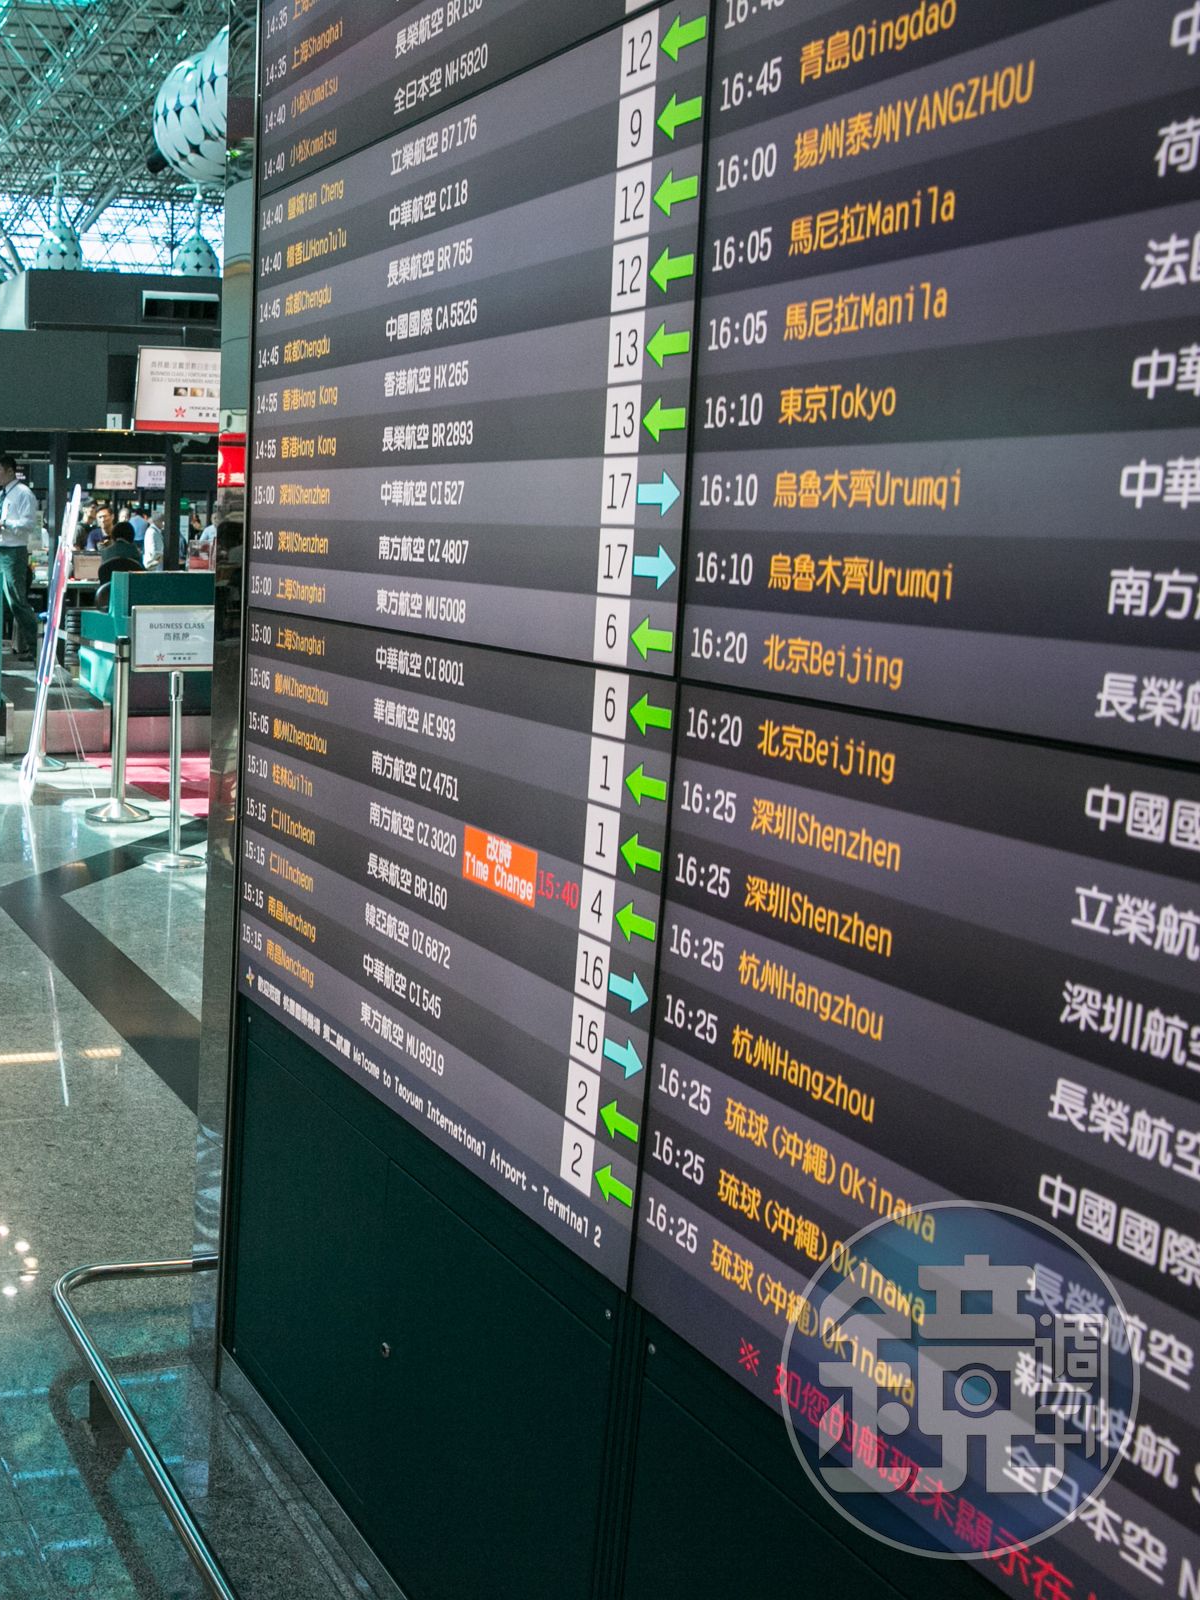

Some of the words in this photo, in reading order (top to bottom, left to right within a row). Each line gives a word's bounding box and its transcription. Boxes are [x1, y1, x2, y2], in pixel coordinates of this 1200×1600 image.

[267, 6, 288, 39] 14:35
[720, 56, 783, 112] 16:45
[800, 0, 957, 85] 青島Qingdao
[265, 55, 287, 87] 14:35
[262, 204, 283, 231] 14:40
[391, 132, 439, 176] 立榮航空
[626, 30, 653, 77] 12
[263, 152, 285, 181] 14:40
[394, 68, 442, 115] 全日本空
[264, 104, 286, 134] 14:40
[716, 142, 777, 193] 16:00
[793, 59, 1036, 172] 揚州泰州YANGZHOU
[260, 252, 282, 277] 14:40
[389, 196, 436, 231] 中華航空
[630, 108, 644, 148] 9
[712, 226, 773, 273] 16:05
[788, 185, 956, 257] 馬尼拉Manila
[259, 298, 281, 324] 14:45
[387, 249, 435, 288] 長榮航空
[619, 181, 646, 224] 12
[258, 345, 279, 369] 14:45
[386, 308, 433, 342] 中國國際
[616, 255, 643, 297] 12
[708, 309, 768, 352] 16:05
[783, 281, 949, 343] 馬尼拉Manila
[256, 392, 278, 415] 14:55
[384, 365, 431, 398] 香港航空
[613, 329, 639, 368] 13
[703, 393, 764, 429] 16:10
[778, 383, 897, 426] 東京Tokyo
[111, 416, 116, 427] 1
[255, 439, 276, 460] 14:55
[382, 424, 429, 452] 長榮航空
[610, 401, 635, 439] 13
[254, 486, 275, 505] 15:00
[381, 481, 427, 507] 中華航空
[607, 473, 632, 509] 17
[699, 473, 758, 507] 16:10
[773, 467, 962, 511] 烏魯木齊Urumqi
[253, 531, 274, 551] 15:00
[379, 536, 425, 564] 南方航空
[603, 544, 629, 580] 17
[695, 552, 754, 587] 16:10
[768, 552, 954, 604] 烏魯木齊Urumqi
[251, 576, 272, 597] 15:00
[376, 589, 423, 620] 東方航空
[606, 614, 617, 649] 6
[251, 624, 272, 646] 15:00
[376, 645, 422, 679] 中華航空
[604, 687, 615, 722] 6
[691, 627, 748, 665] 16:20
[763, 633, 904, 692] 北京Beijing
[250, 668, 271, 691] 15:05
[374, 697, 419, 732] 華信航空
[600, 755, 610, 791] 1
[686, 707, 743, 747] 16:20
[757, 719, 896, 786] 北京Beijing
[249, 711, 269, 735] 15:05
[371, 750, 417, 788] 南方航空
[595, 822, 606, 858] 1
[247, 754, 268, 780] 15:10
[369, 801, 414, 842] 南方航空
[537, 870, 580, 910] 15:40
[590, 889, 603, 924] 4
[465, 851, 489, 882] Time
[494, 864, 533, 901] Change
[680, 780, 737, 824] 16:25
[751, 796, 901, 872] 深圳Shenzhen
[1071, 885, 1200, 961] 立榮航
[246, 797, 267, 823] 15:15
[367, 852, 412, 895] 長榮航空
[580, 951, 604, 989] 16
[675, 853, 731, 898] 16:25
[744, 874, 893, 958] 深圳Shenzhen
[245, 840, 265, 866] 15:15
[575, 1014, 599, 1054] 16
[669, 924, 724, 972] 16:25
[738, 950, 884, 1043] 杭州Hangzhou
[243, 881, 264, 909] 15:15
[363, 953, 407, 999] 中華航空
[576, 1080, 588, 1116] 2
[242, 923, 263, 951] 15:15
[360, 1001, 404, 1051] 東方航空
[571, 1142, 583, 1178] 2
[658, 1063, 712, 1116] 16:25
[353, 1042, 380, 1080] Welcome
[382, 1068, 392, 1088] to
[394, 1076, 424, 1114] Taoyuan
[427, 1101, 486, 1160] International
[489, 1150, 527, 1191] Airport
[542, 1185, 589, 1238] Terminal
[593, 1225, 602, 1249] 2
[652, 1131, 705, 1186] 16:25
[664, 994, 718, 1045] 16:25
[732, 1024, 876, 1124] 杭州Hangzhou
[1039, 1174, 1200, 1287] 中國國際
[646, 1196, 698, 1254] 16:25
